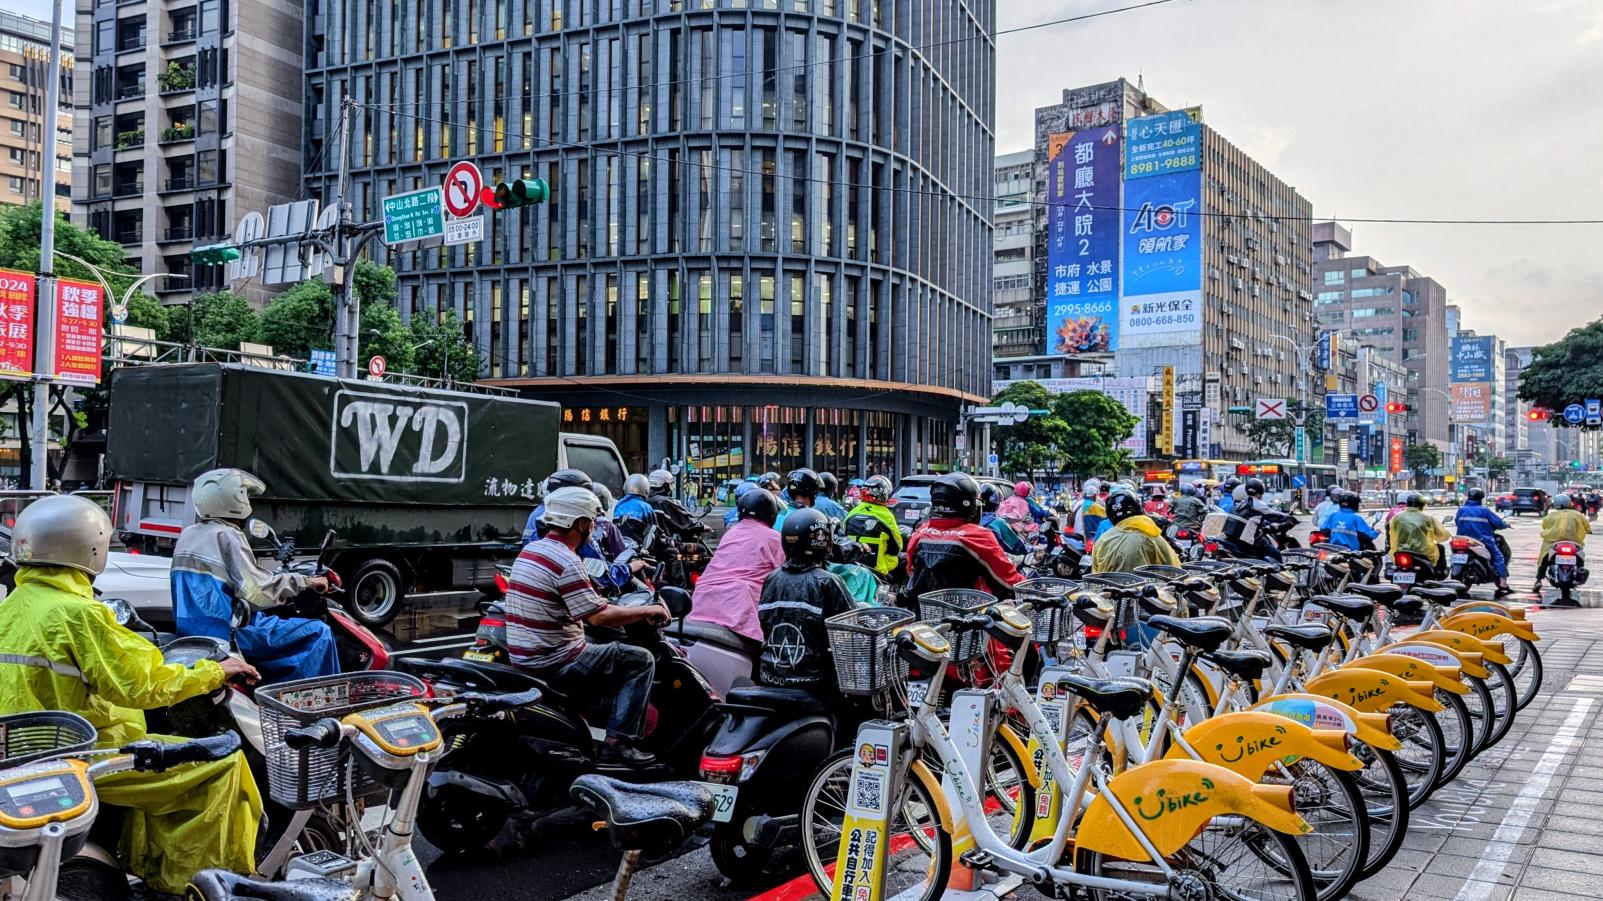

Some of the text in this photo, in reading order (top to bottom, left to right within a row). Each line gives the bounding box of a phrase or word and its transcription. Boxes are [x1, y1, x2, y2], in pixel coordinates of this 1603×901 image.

[1055, 144, 1063, 157] 3
[1130, 155, 1196, 175] 8981-9888
[389, 193, 434, 212] 中山北路二段
[1139, 234, 1190, 254] 領航家
[1055, 260, 1112, 278] 市府 水景
[62, 286, 98, 304] 秋季
[1055, 278, 1112, 296] 捷運 公園
[1054, 301, 1112, 316] 2995-8666
[1129, 314, 1195, 328] 0800-668-850
[564, 408, 628, 421] 陽信銀行
[341, 401, 461, 473] WD
[755, 434, 857, 458] 陽信銀行
[858, 830, 877, 884] 記得加入
